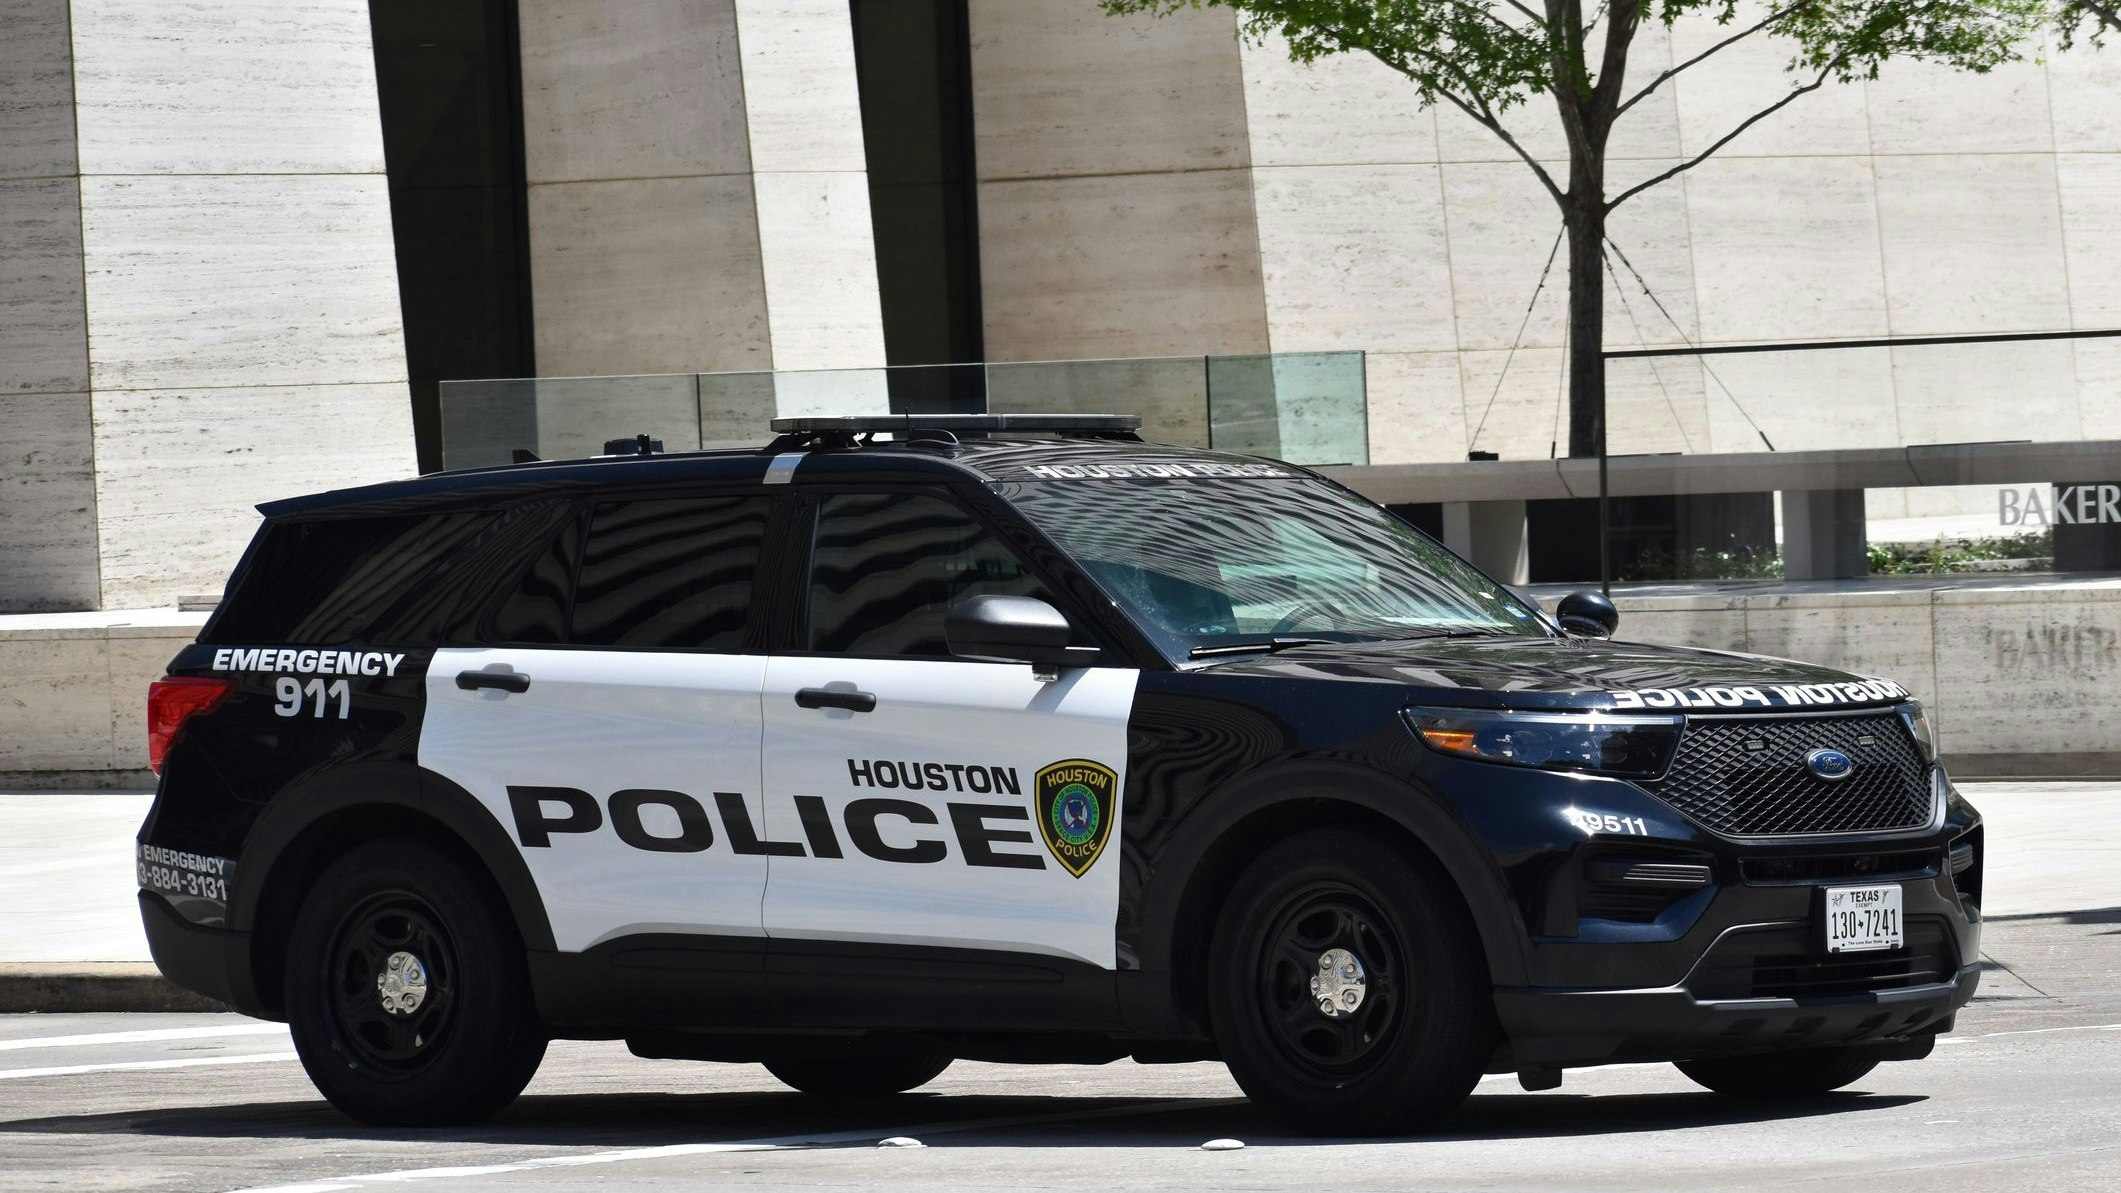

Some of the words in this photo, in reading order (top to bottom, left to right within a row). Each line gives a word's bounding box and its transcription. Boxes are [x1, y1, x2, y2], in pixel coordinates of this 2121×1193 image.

[1023, 464, 1197, 478] HOUSTON
[1998, 484, 2121, 526] BAKER
[212, 648, 406, 677] EMERGENCY
[274, 676, 350, 720] 911
[847, 758, 1022, 796] HOUSTON
[1046, 769, 1107, 789] HOUSTON
[505, 785, 1047, 871] POLICE
[143, 843, 225, 876] EMERGENCY
[1055, 838, 1098, 858] POLICE
[1850, 890, 1879, 903] TEXAS
